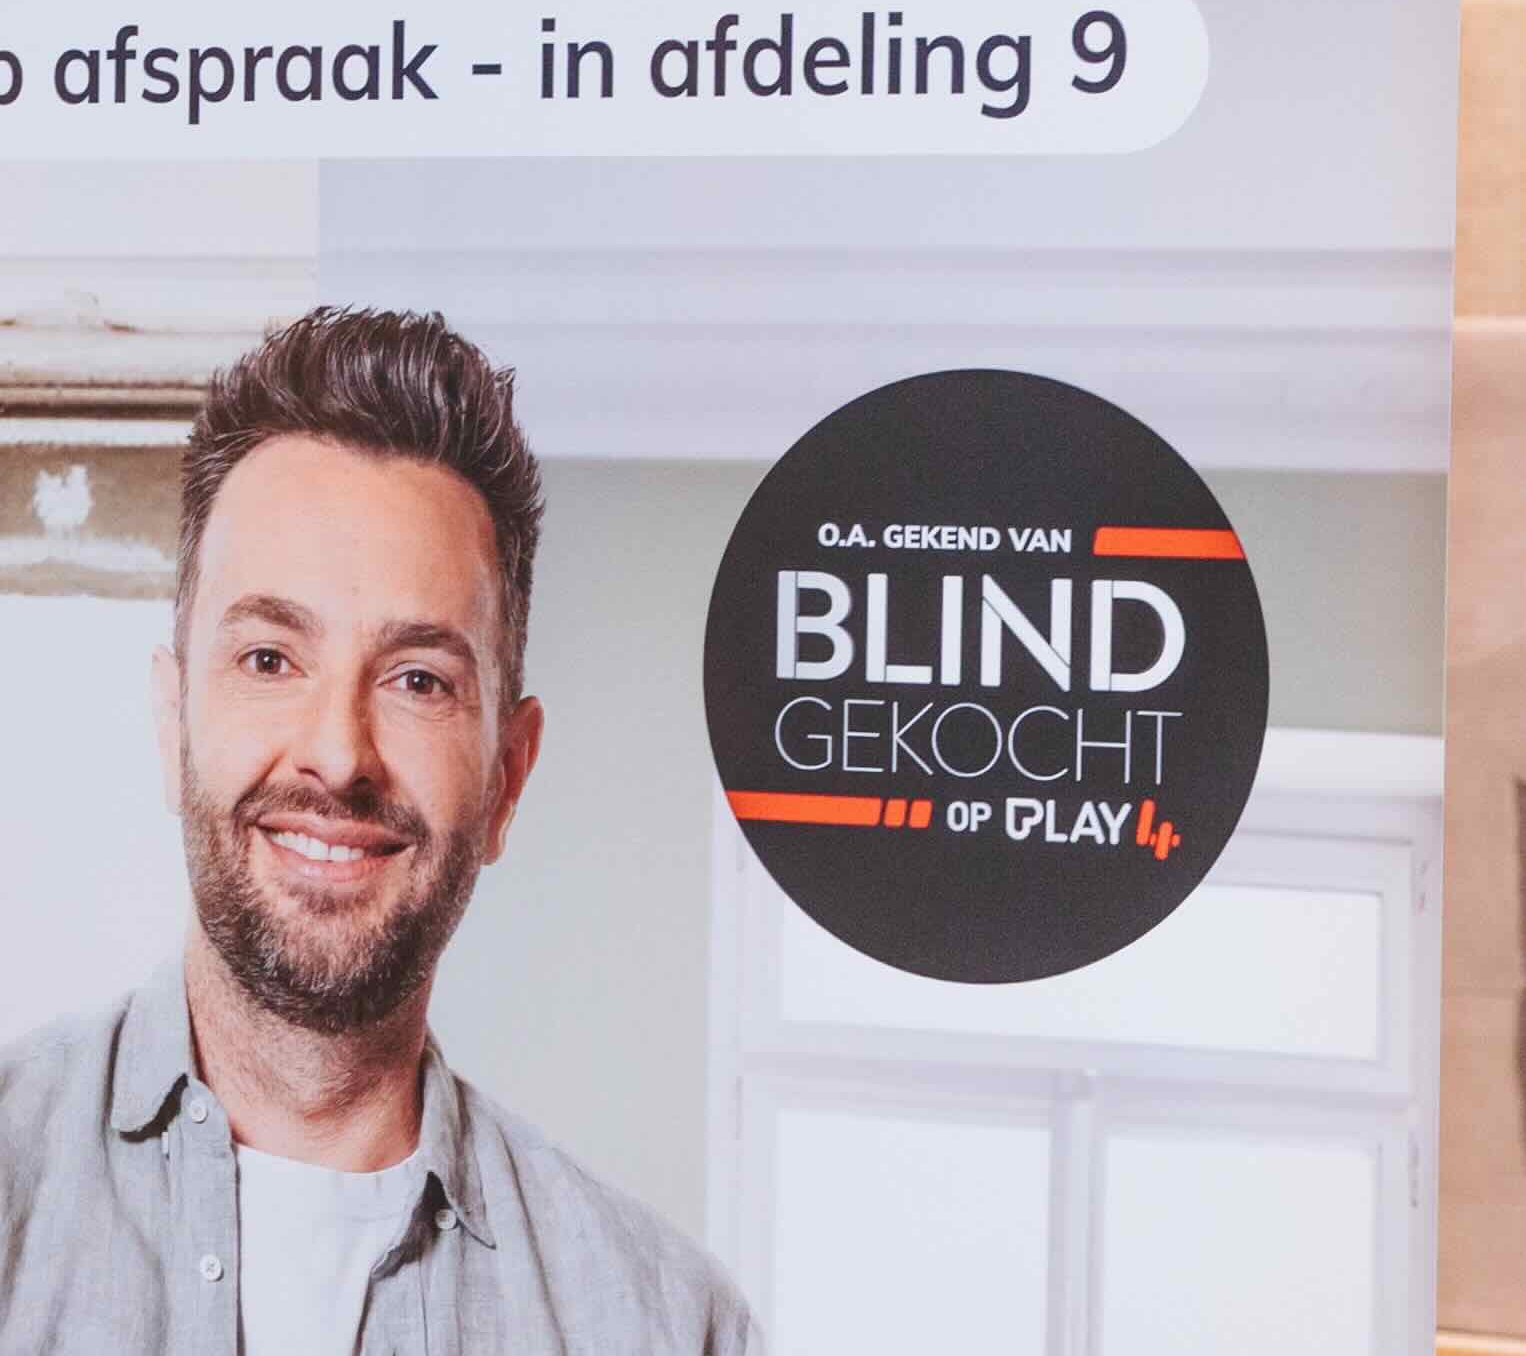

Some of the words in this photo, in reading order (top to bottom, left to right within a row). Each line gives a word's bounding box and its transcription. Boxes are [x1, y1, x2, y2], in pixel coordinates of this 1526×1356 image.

[53, 19, 439, 124] afspraak
[471, 62, 503, 75] -
[540, 17, 615, 100] in
[649, 11, 1033, 119] afdeling
[1070, 10, 1128, 94] 9
[816, 522, 876, 548] O.A.
[882, 523, 1001, 551] GEKEND
[1007, 526, 1073, 553] VAN
[775, 569, 1187, 693] BLIND
[773, 695, 1184, 786] GEKOCHT
[945, 799, 993, 833] OP
